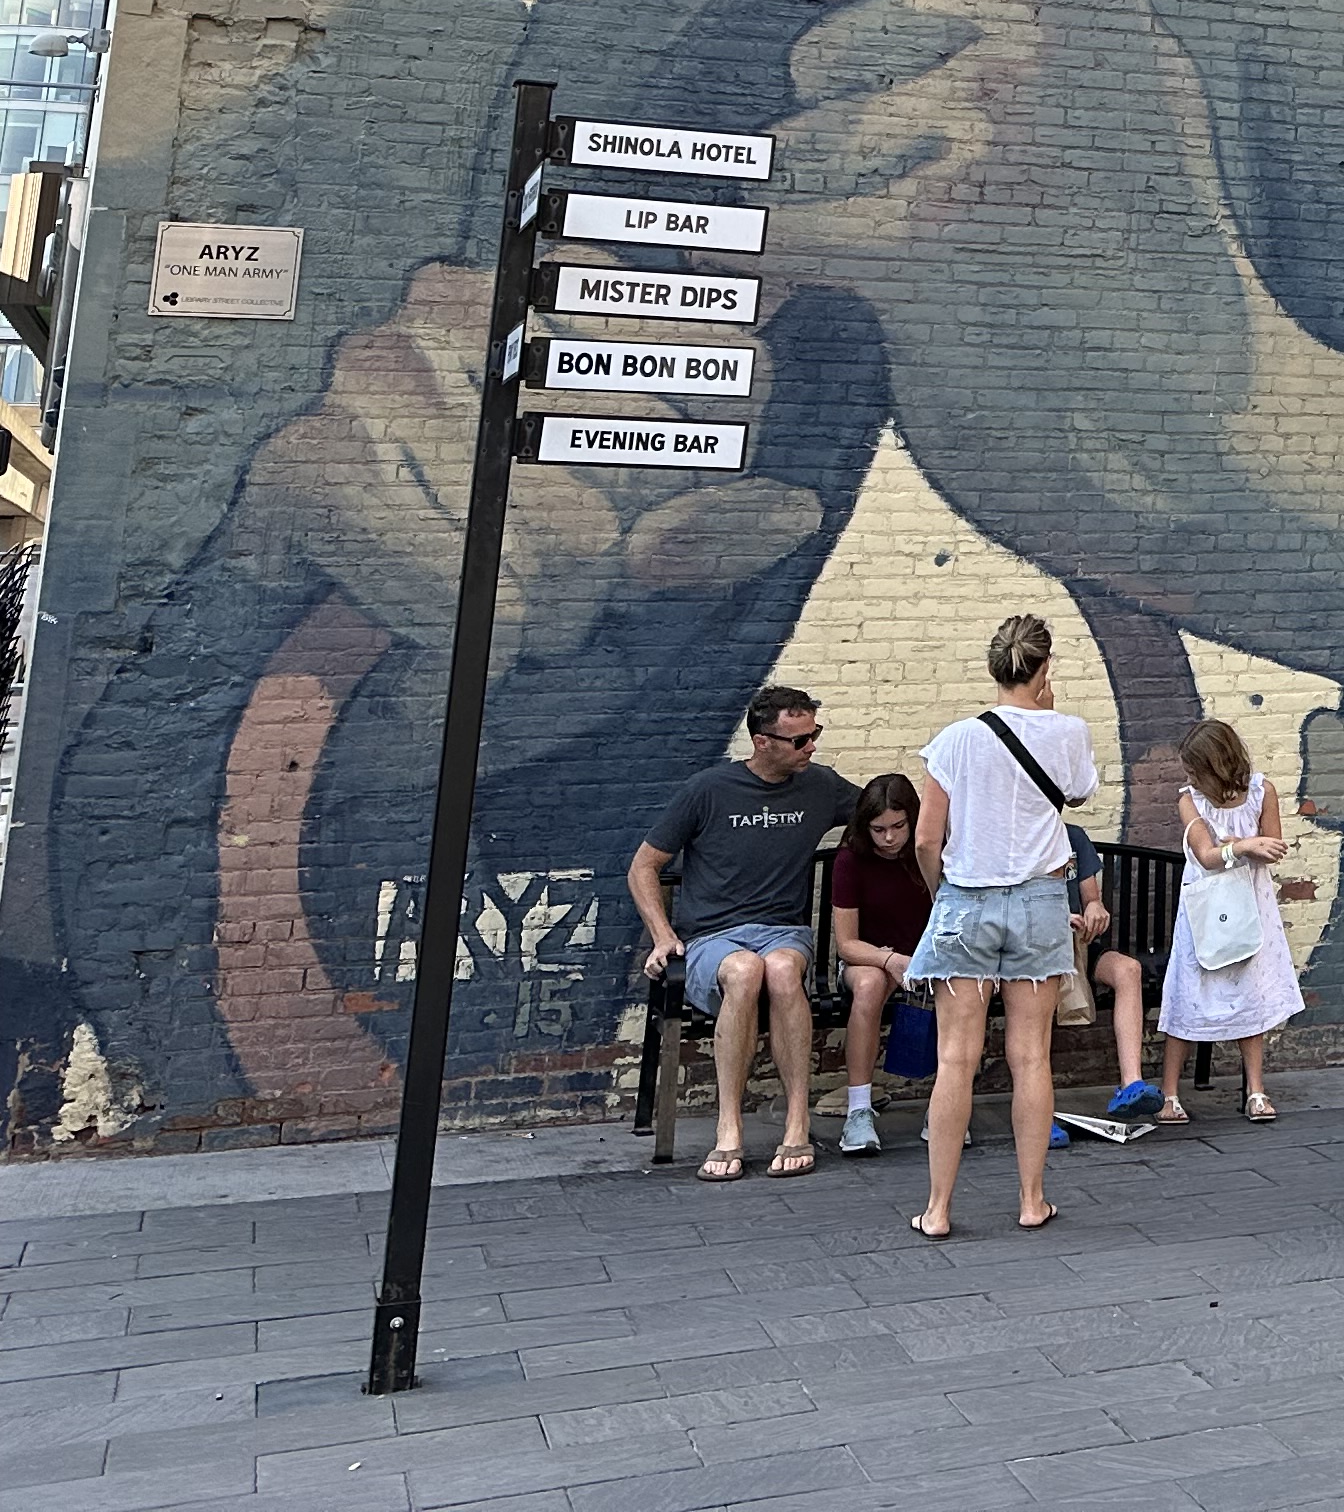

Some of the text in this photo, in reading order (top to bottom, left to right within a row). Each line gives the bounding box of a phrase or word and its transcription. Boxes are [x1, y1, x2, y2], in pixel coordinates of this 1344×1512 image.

[587, 133, 758, 165] SHINOLA HOTEL
[624, 209, 710, 235] LIP BAR
[198, 244, 260, 262] ARYZ
[204, 266, 238, 277] MAN
[211, 297, 240, 305] STREET
[579, 278, 738, 310] MISTER DIPS
[557, 352, 739, 382] BON BON BON
[569, 429, 720, 455] EVENING BAR
